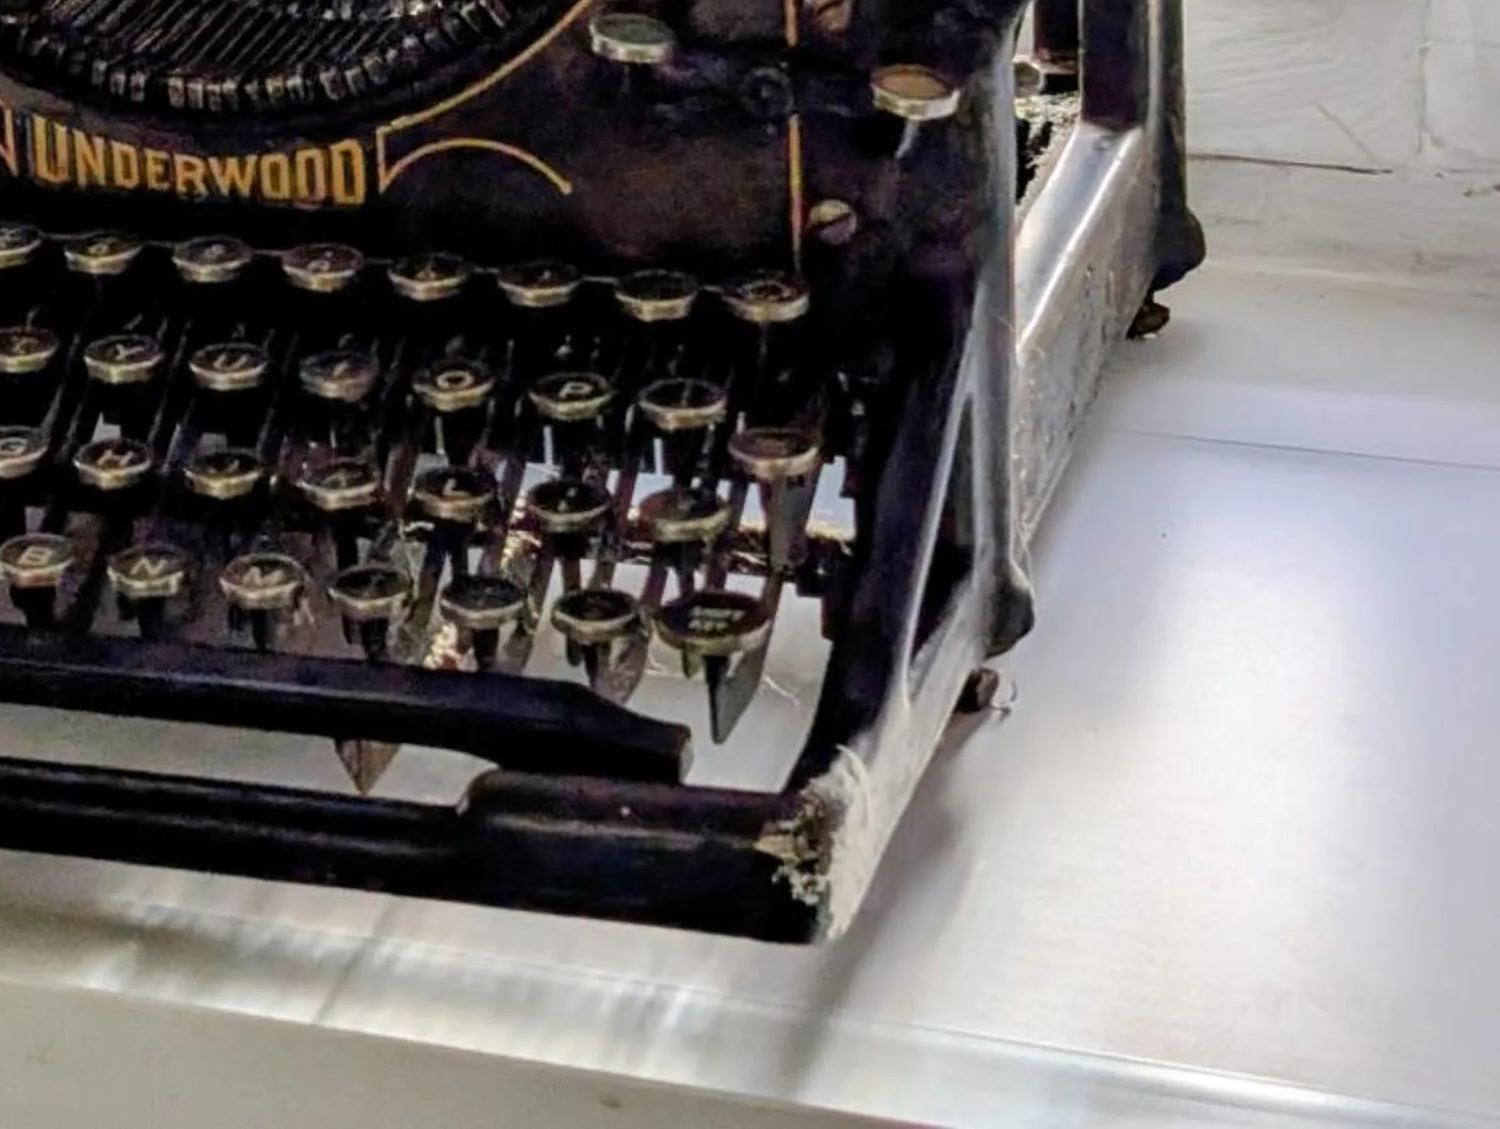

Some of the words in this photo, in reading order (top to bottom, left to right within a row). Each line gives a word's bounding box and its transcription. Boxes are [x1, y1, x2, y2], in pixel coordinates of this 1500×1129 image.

[31, 113, 366, 207] UNDERWOOD
[558, 382, 592, 398] P
[18, 545, 53, 566] B
[130, 557, 170, 577] N
